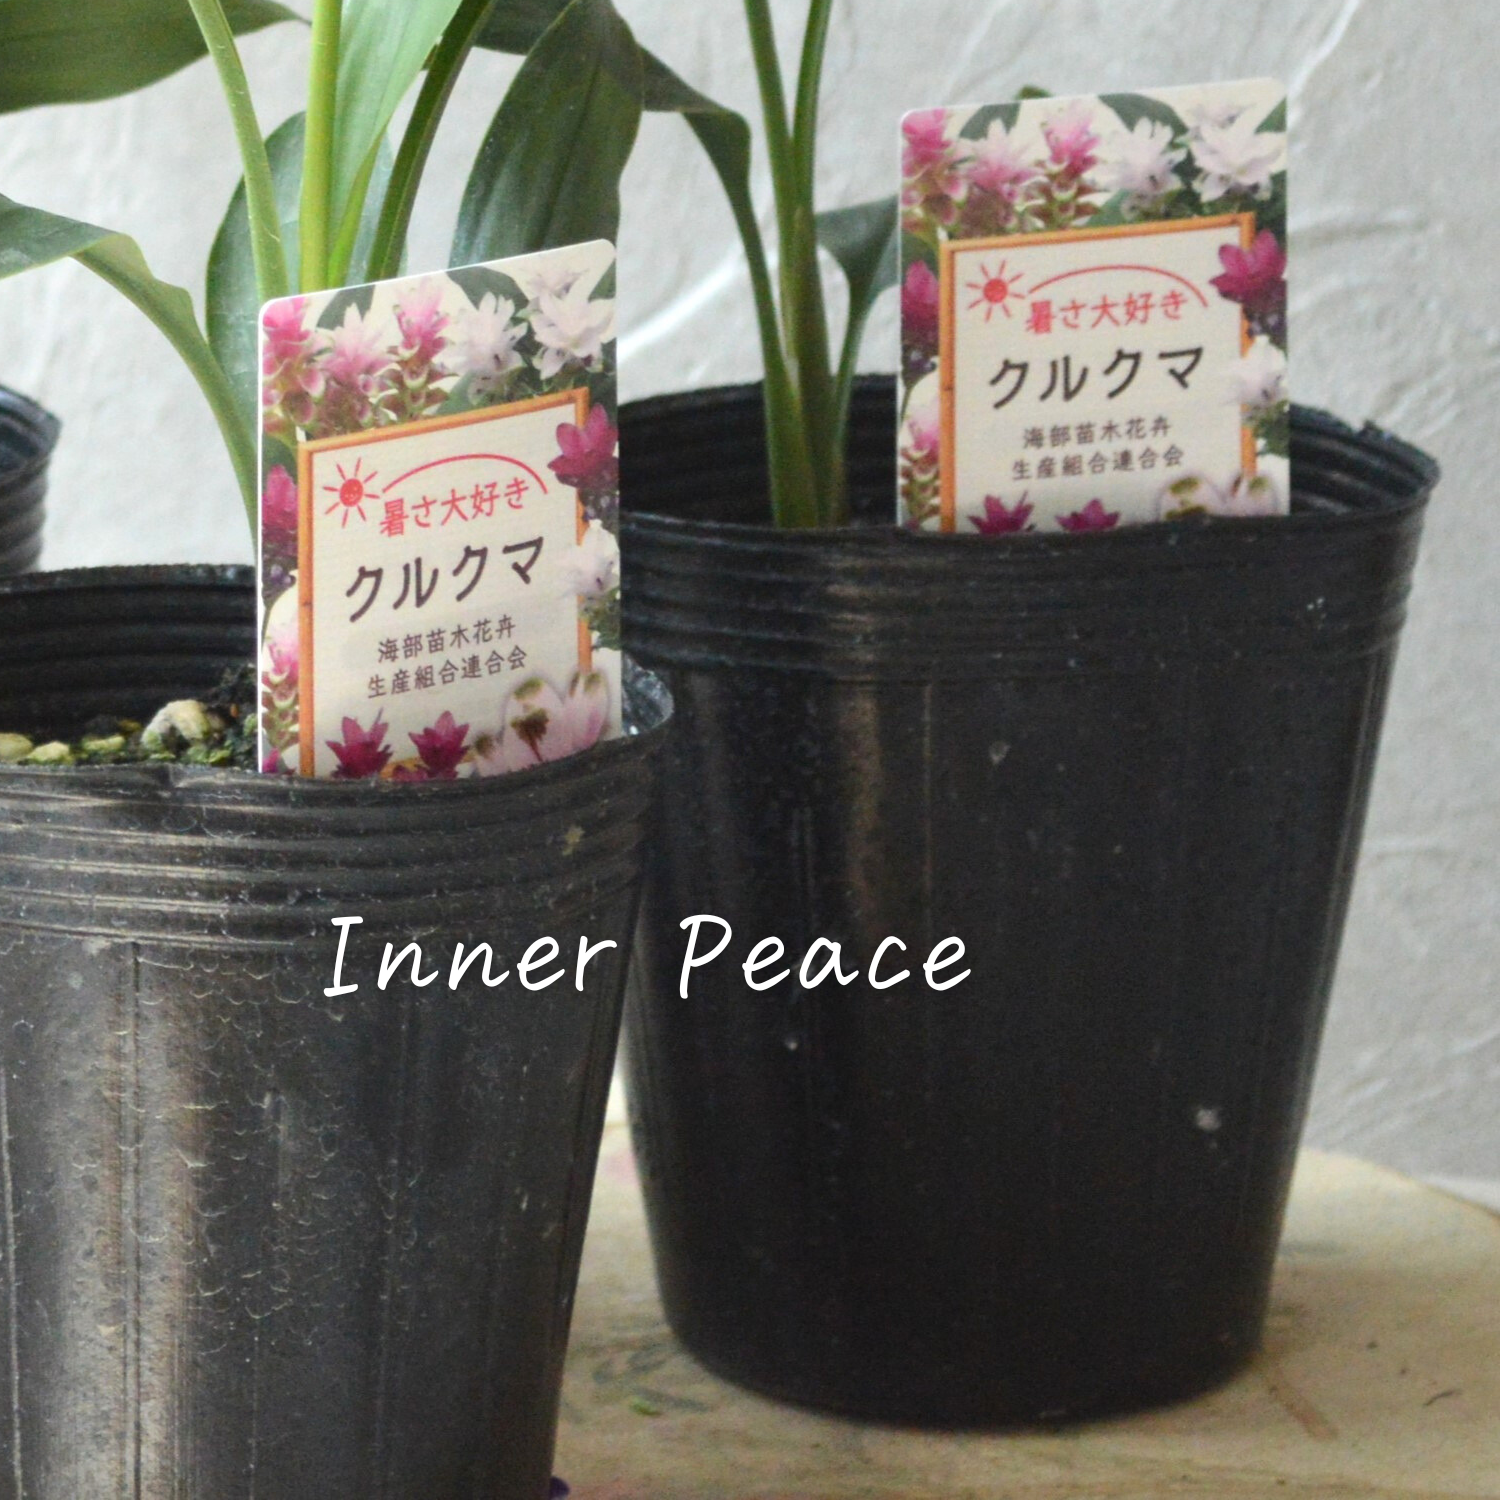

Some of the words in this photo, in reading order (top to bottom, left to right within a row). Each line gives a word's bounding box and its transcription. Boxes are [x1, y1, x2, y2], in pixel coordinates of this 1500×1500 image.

[1025, 289, 1189, 334] 暑さ大好き
[989, 346, 1204, 410] クルクマ
[1023, 416, 1173, 451] 海部苗木花卉
[1011, 444, 1185, 481] 生産組合連合会
[379, 476, 530, 537] 暑さ大好き
[345, 536, 545, 623] クルクマ
[378, 614, 517, 663] 海部苗木花卉
[367, 644, 527, 699] 生産組合連合会
